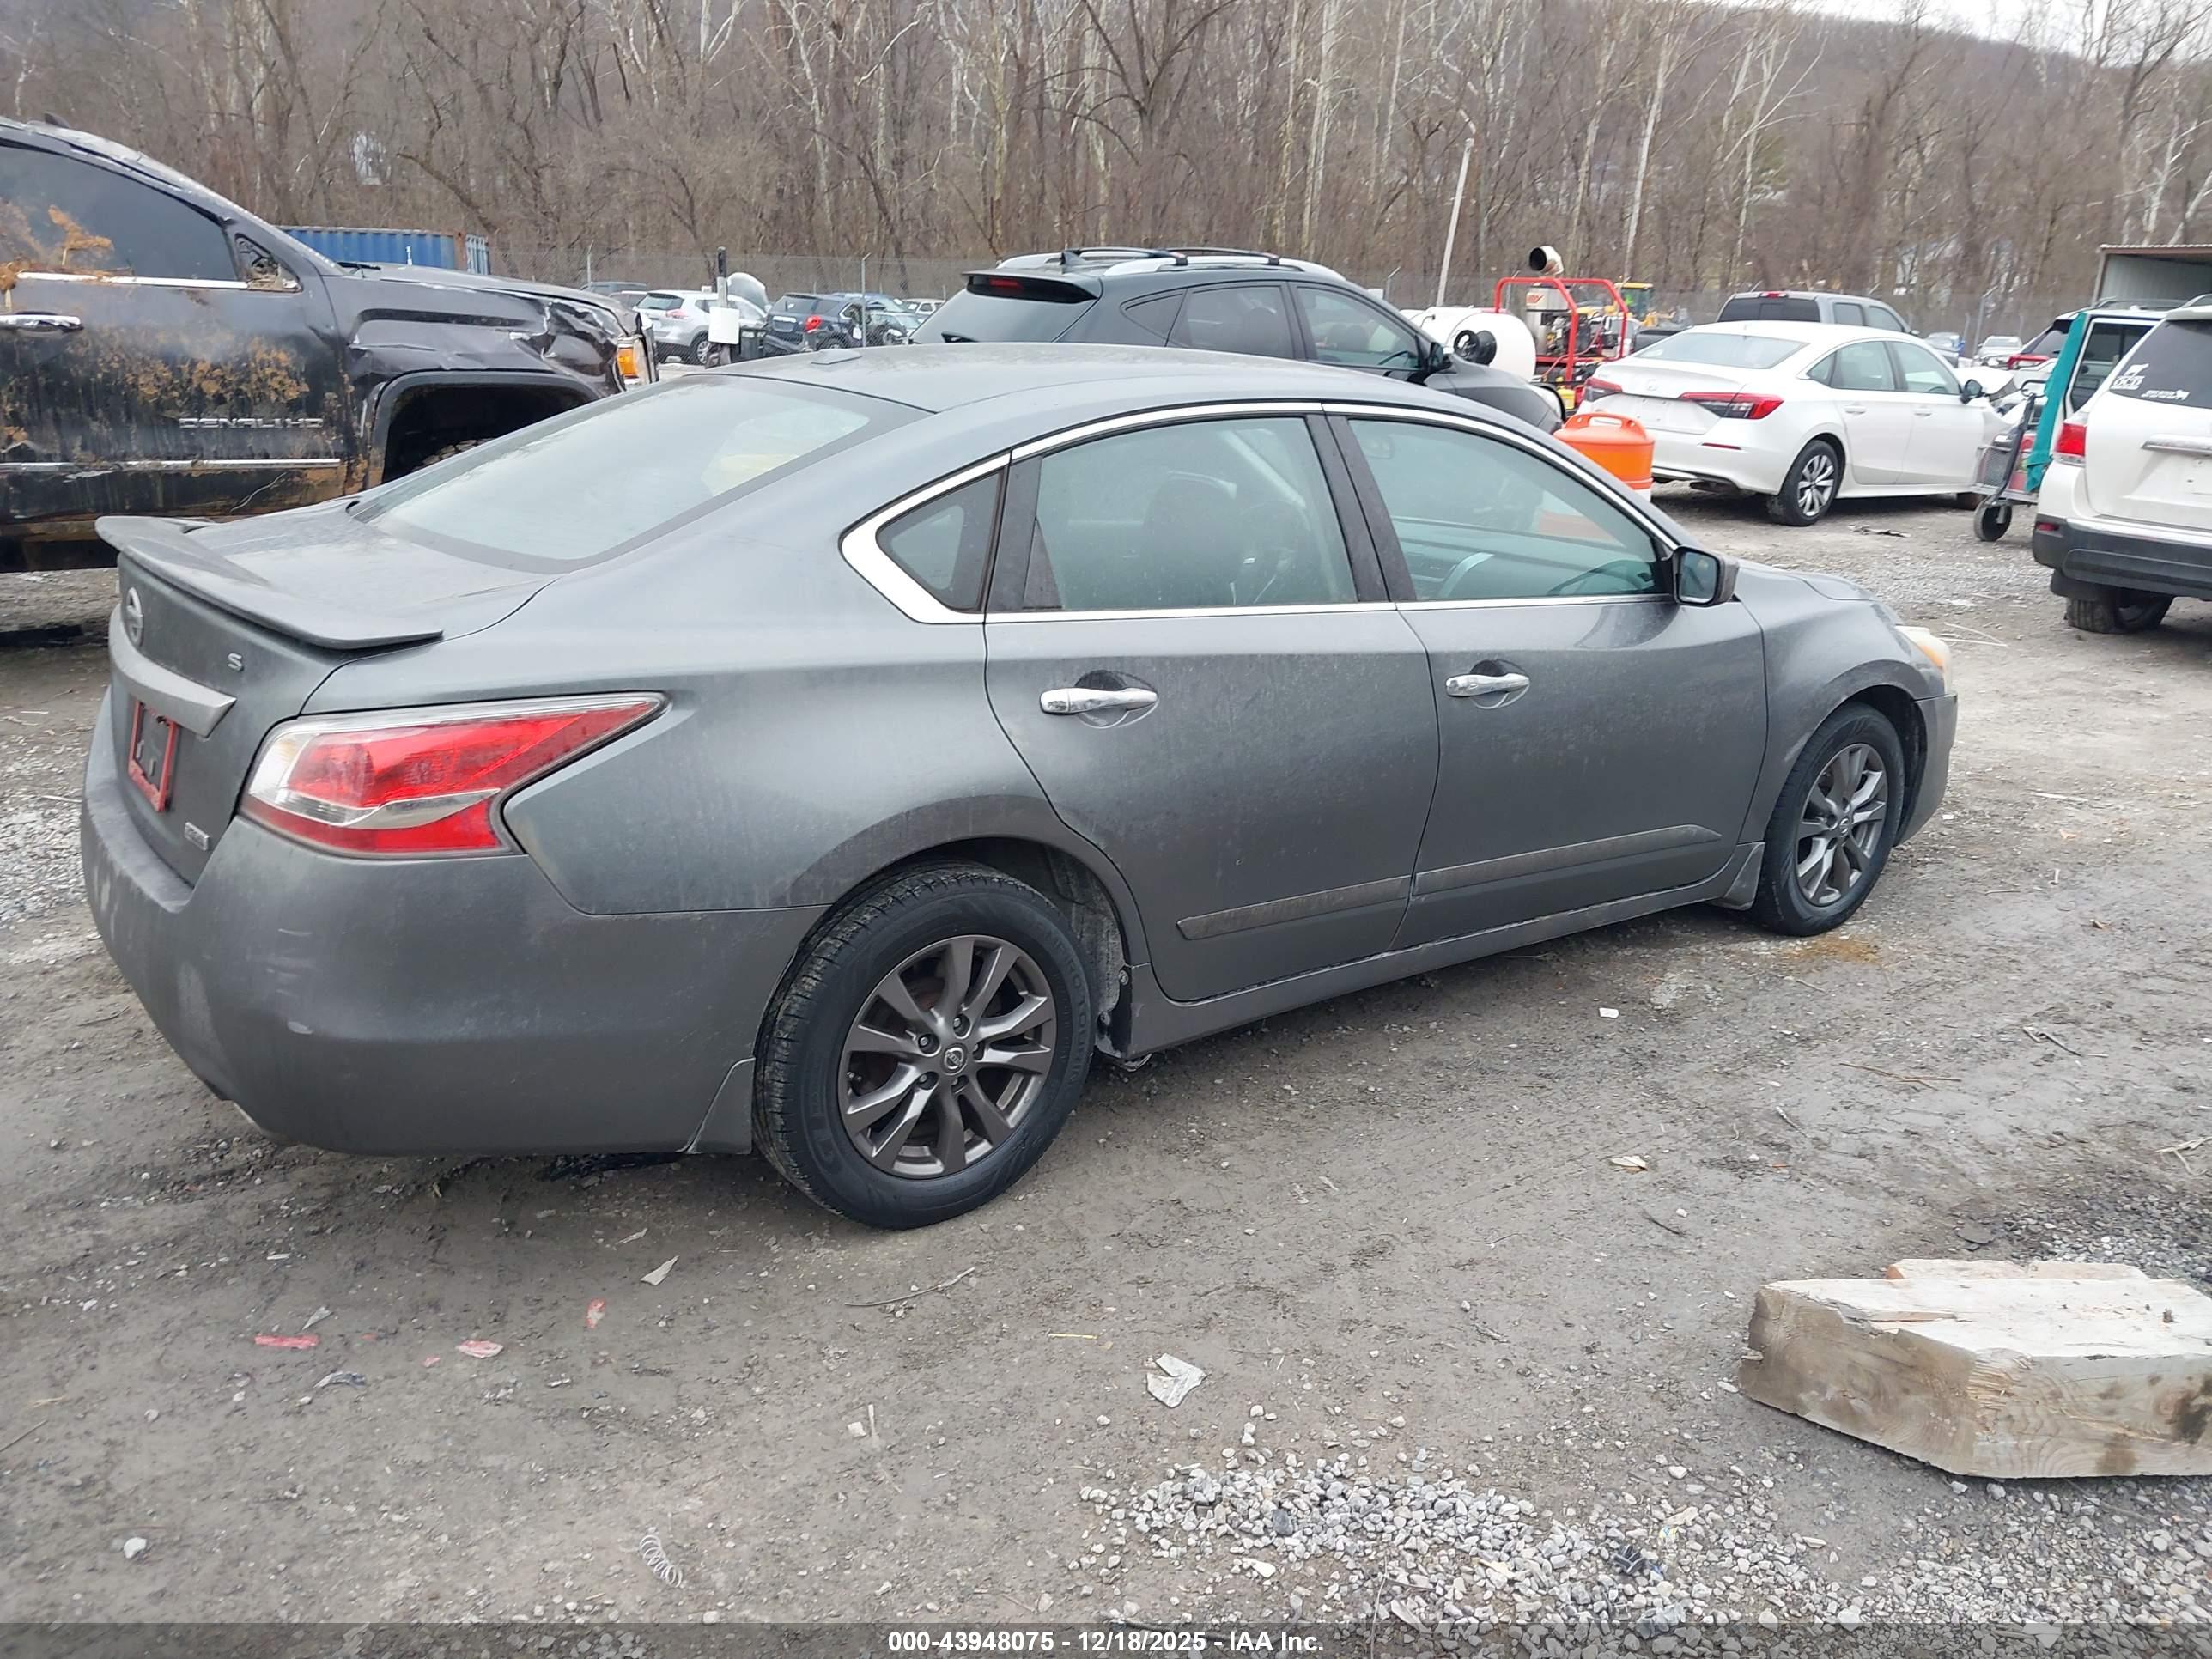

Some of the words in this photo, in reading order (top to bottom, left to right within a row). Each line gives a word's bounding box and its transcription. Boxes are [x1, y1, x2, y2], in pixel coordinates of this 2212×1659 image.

[179, 418, 283, 428] DENALI
[285, 418, 325, 428] HD
[227, 652, 242, 671] S
